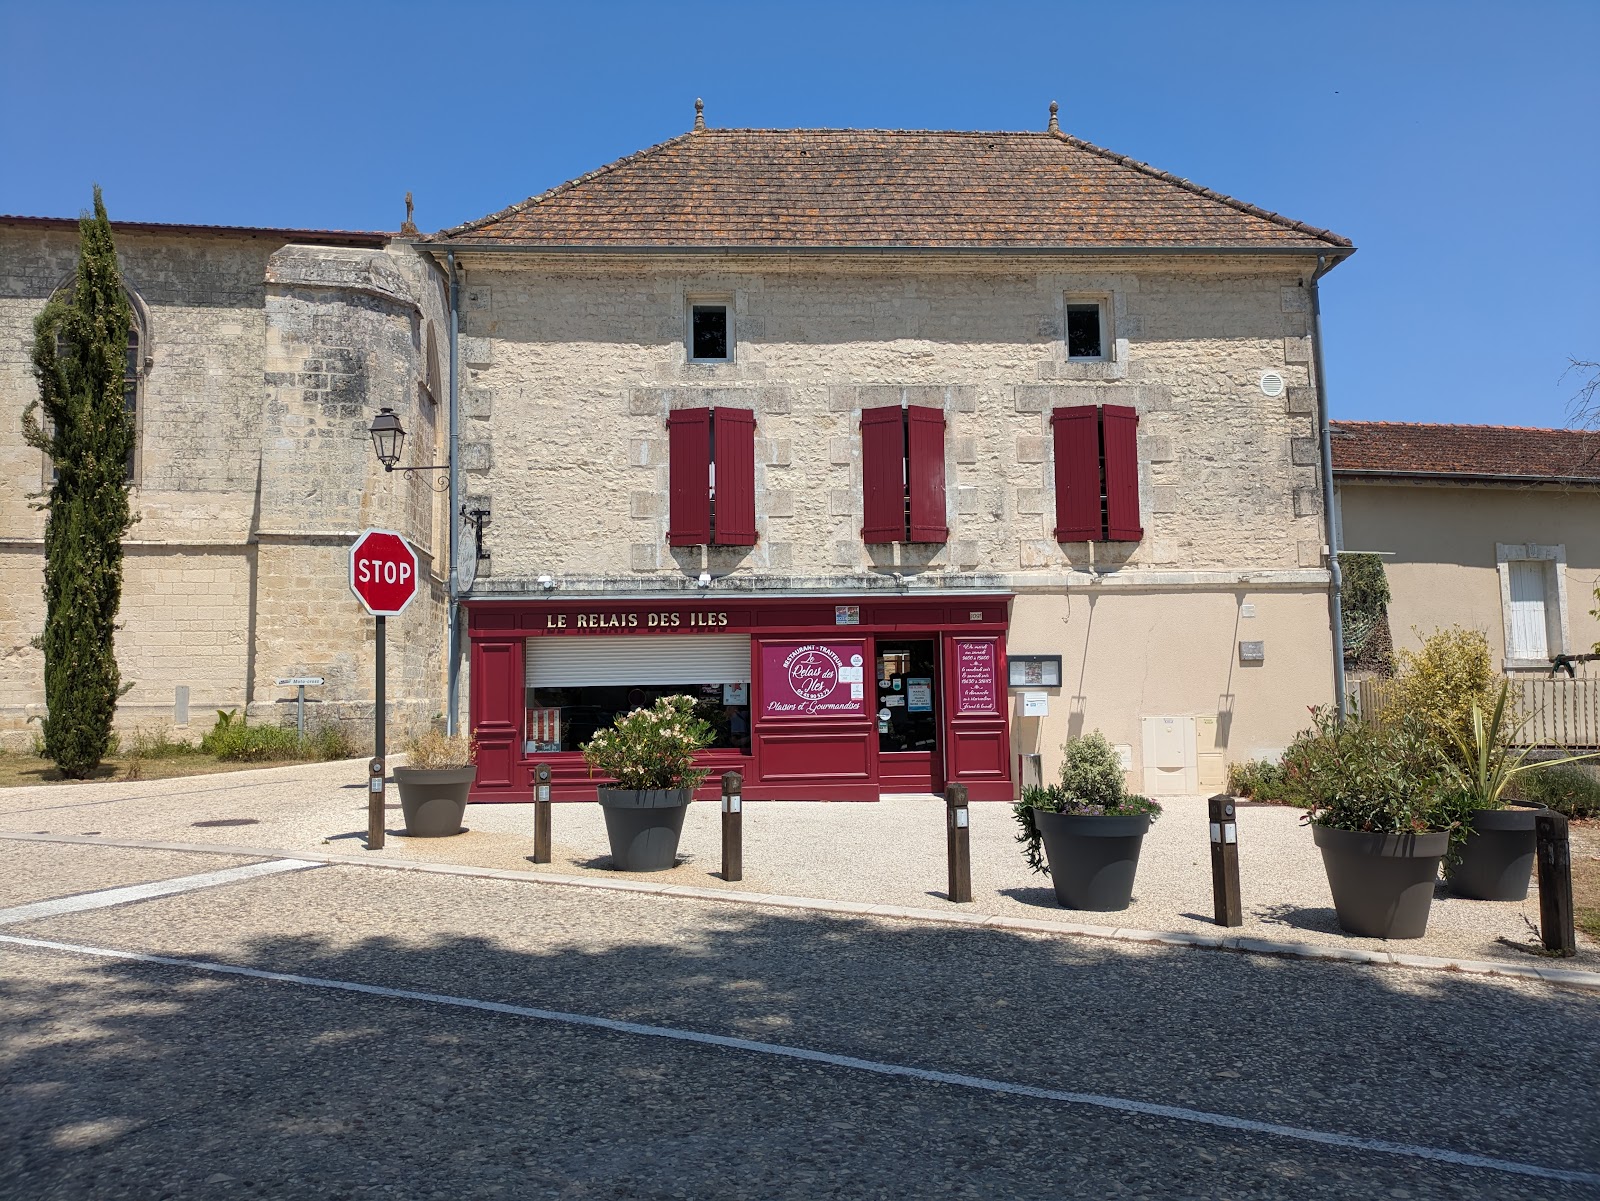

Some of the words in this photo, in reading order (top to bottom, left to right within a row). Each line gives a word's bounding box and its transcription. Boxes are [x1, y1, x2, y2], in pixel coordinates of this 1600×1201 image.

[358, 558, 412, 584] STOP
[547, 614, 567, 628] LE
[578, 613, 638, 628] RELAIS
[648, 612, 680, 626] DES
[690, 612, 728, 626] ILES
[783, 645, 815, 668] RESTAURANT
[820, 646, 843, 668] TRAITEUR
[792, 664, 822, 679] Relais
[822, 669, 834, 678] des
[767, 701, 796, 711] Plaisirs
[798, 701, 809, 710] et
[806, 700, 860, 715] Gourmandises
